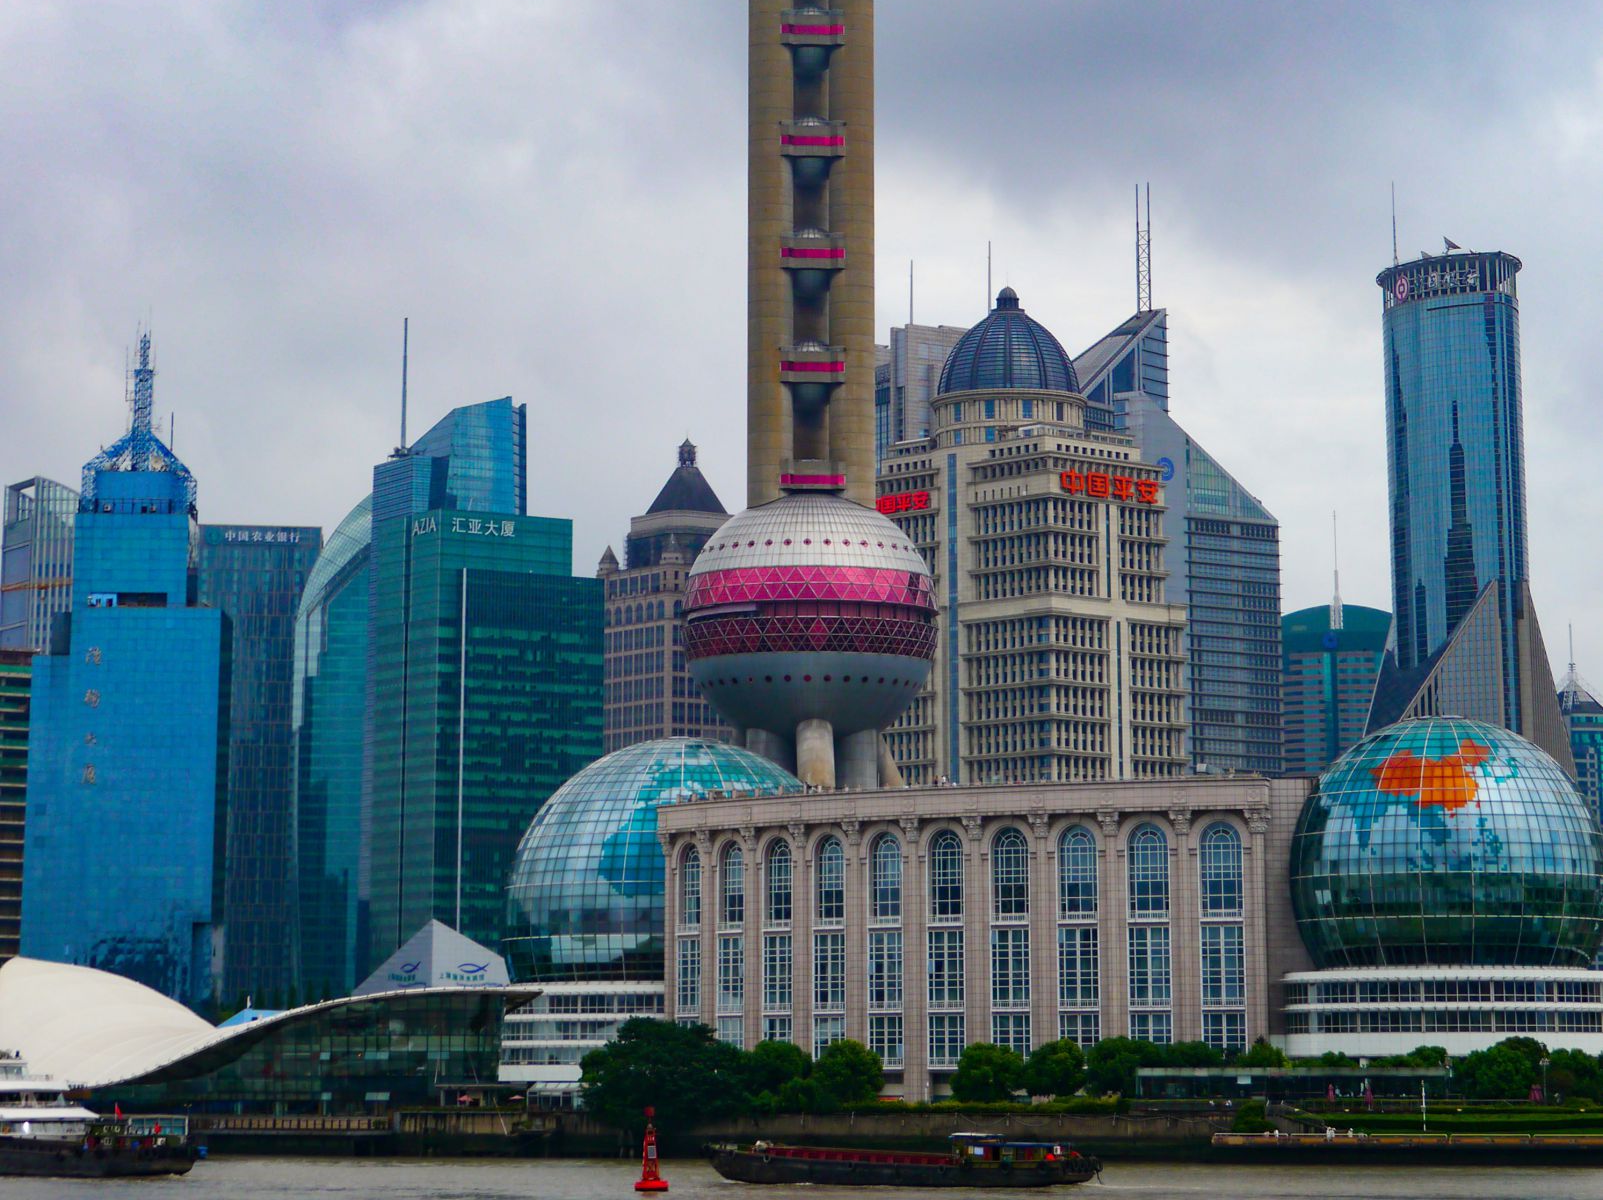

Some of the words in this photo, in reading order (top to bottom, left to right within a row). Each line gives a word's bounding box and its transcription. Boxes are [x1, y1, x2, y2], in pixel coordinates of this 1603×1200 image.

[1060, 467, 1158, 504] 中国平安
[412, 517, 436, 536] AZIA
[452, 517, 515, 537] 汇亚大厦
